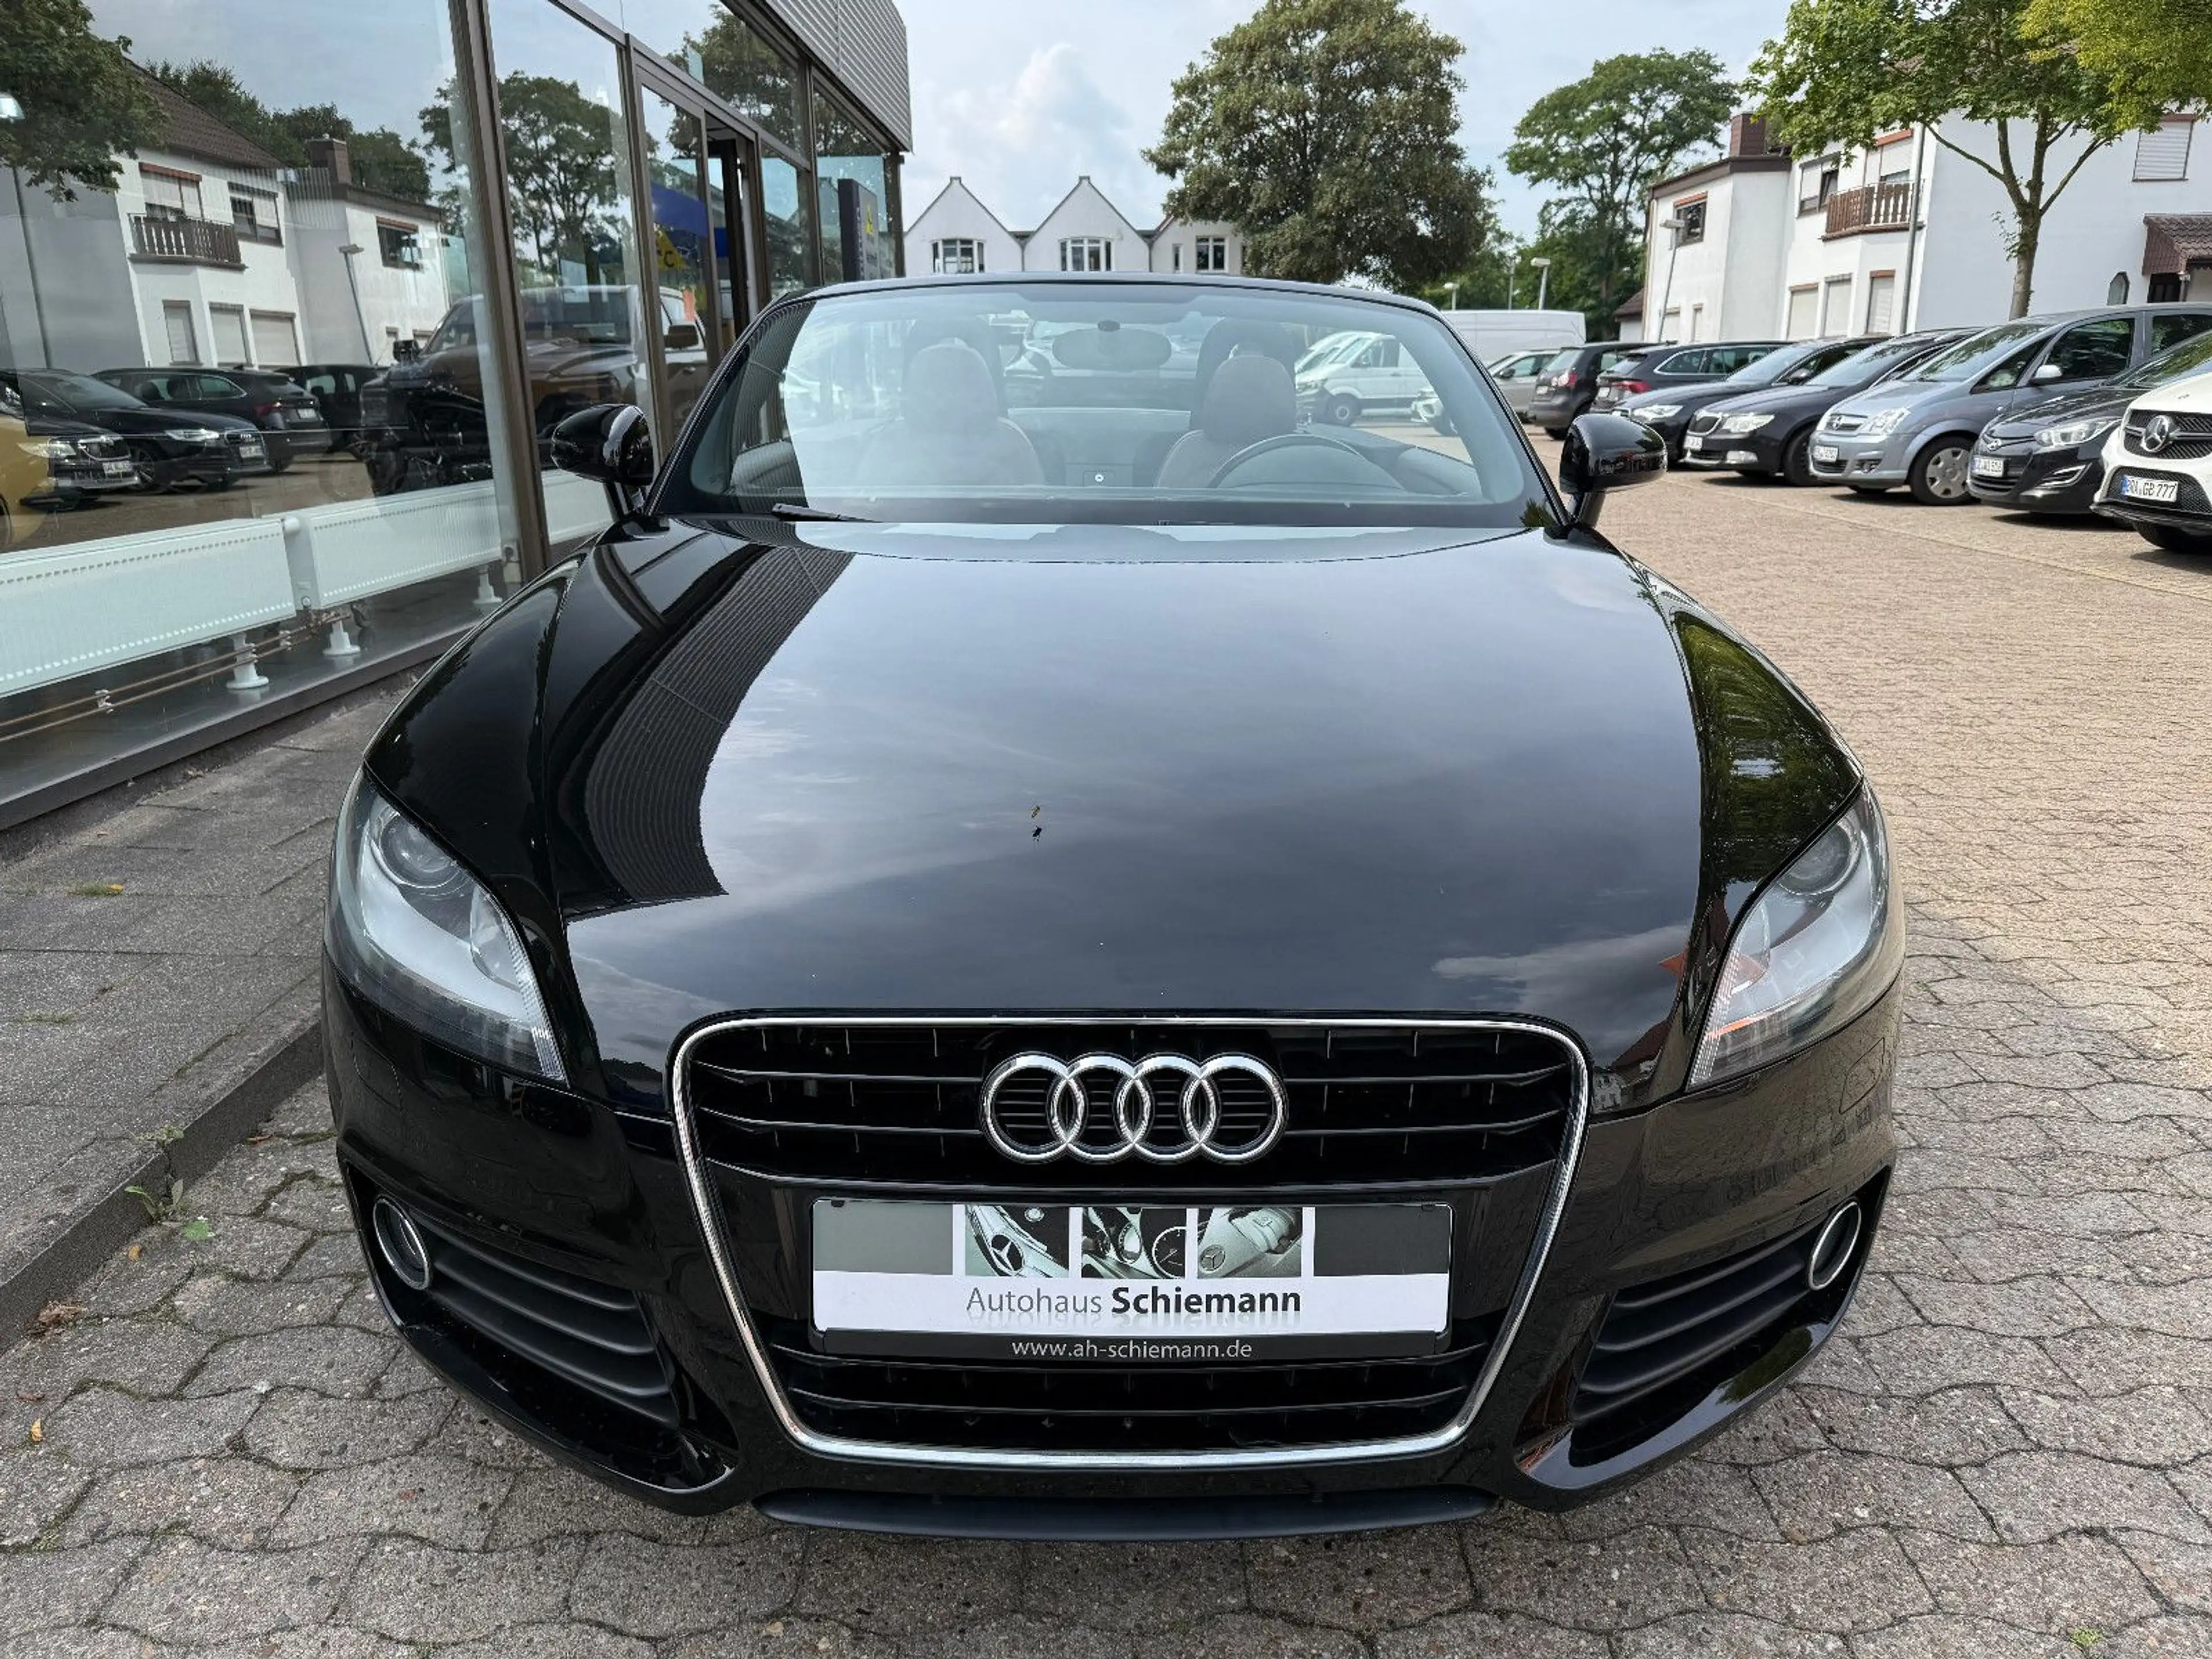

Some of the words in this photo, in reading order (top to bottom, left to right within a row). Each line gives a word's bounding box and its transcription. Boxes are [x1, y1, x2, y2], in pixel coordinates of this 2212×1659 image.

[2143, 482, 2155, 496] GB
[2157, 483, 2176, 498] 777
[966, 1287, 1102, 1313] Autohaus
[1112, 1286, 1301, 1315] Schiemann
[1012, 1339, 1253, 1358] www.ah-schiemann.de
